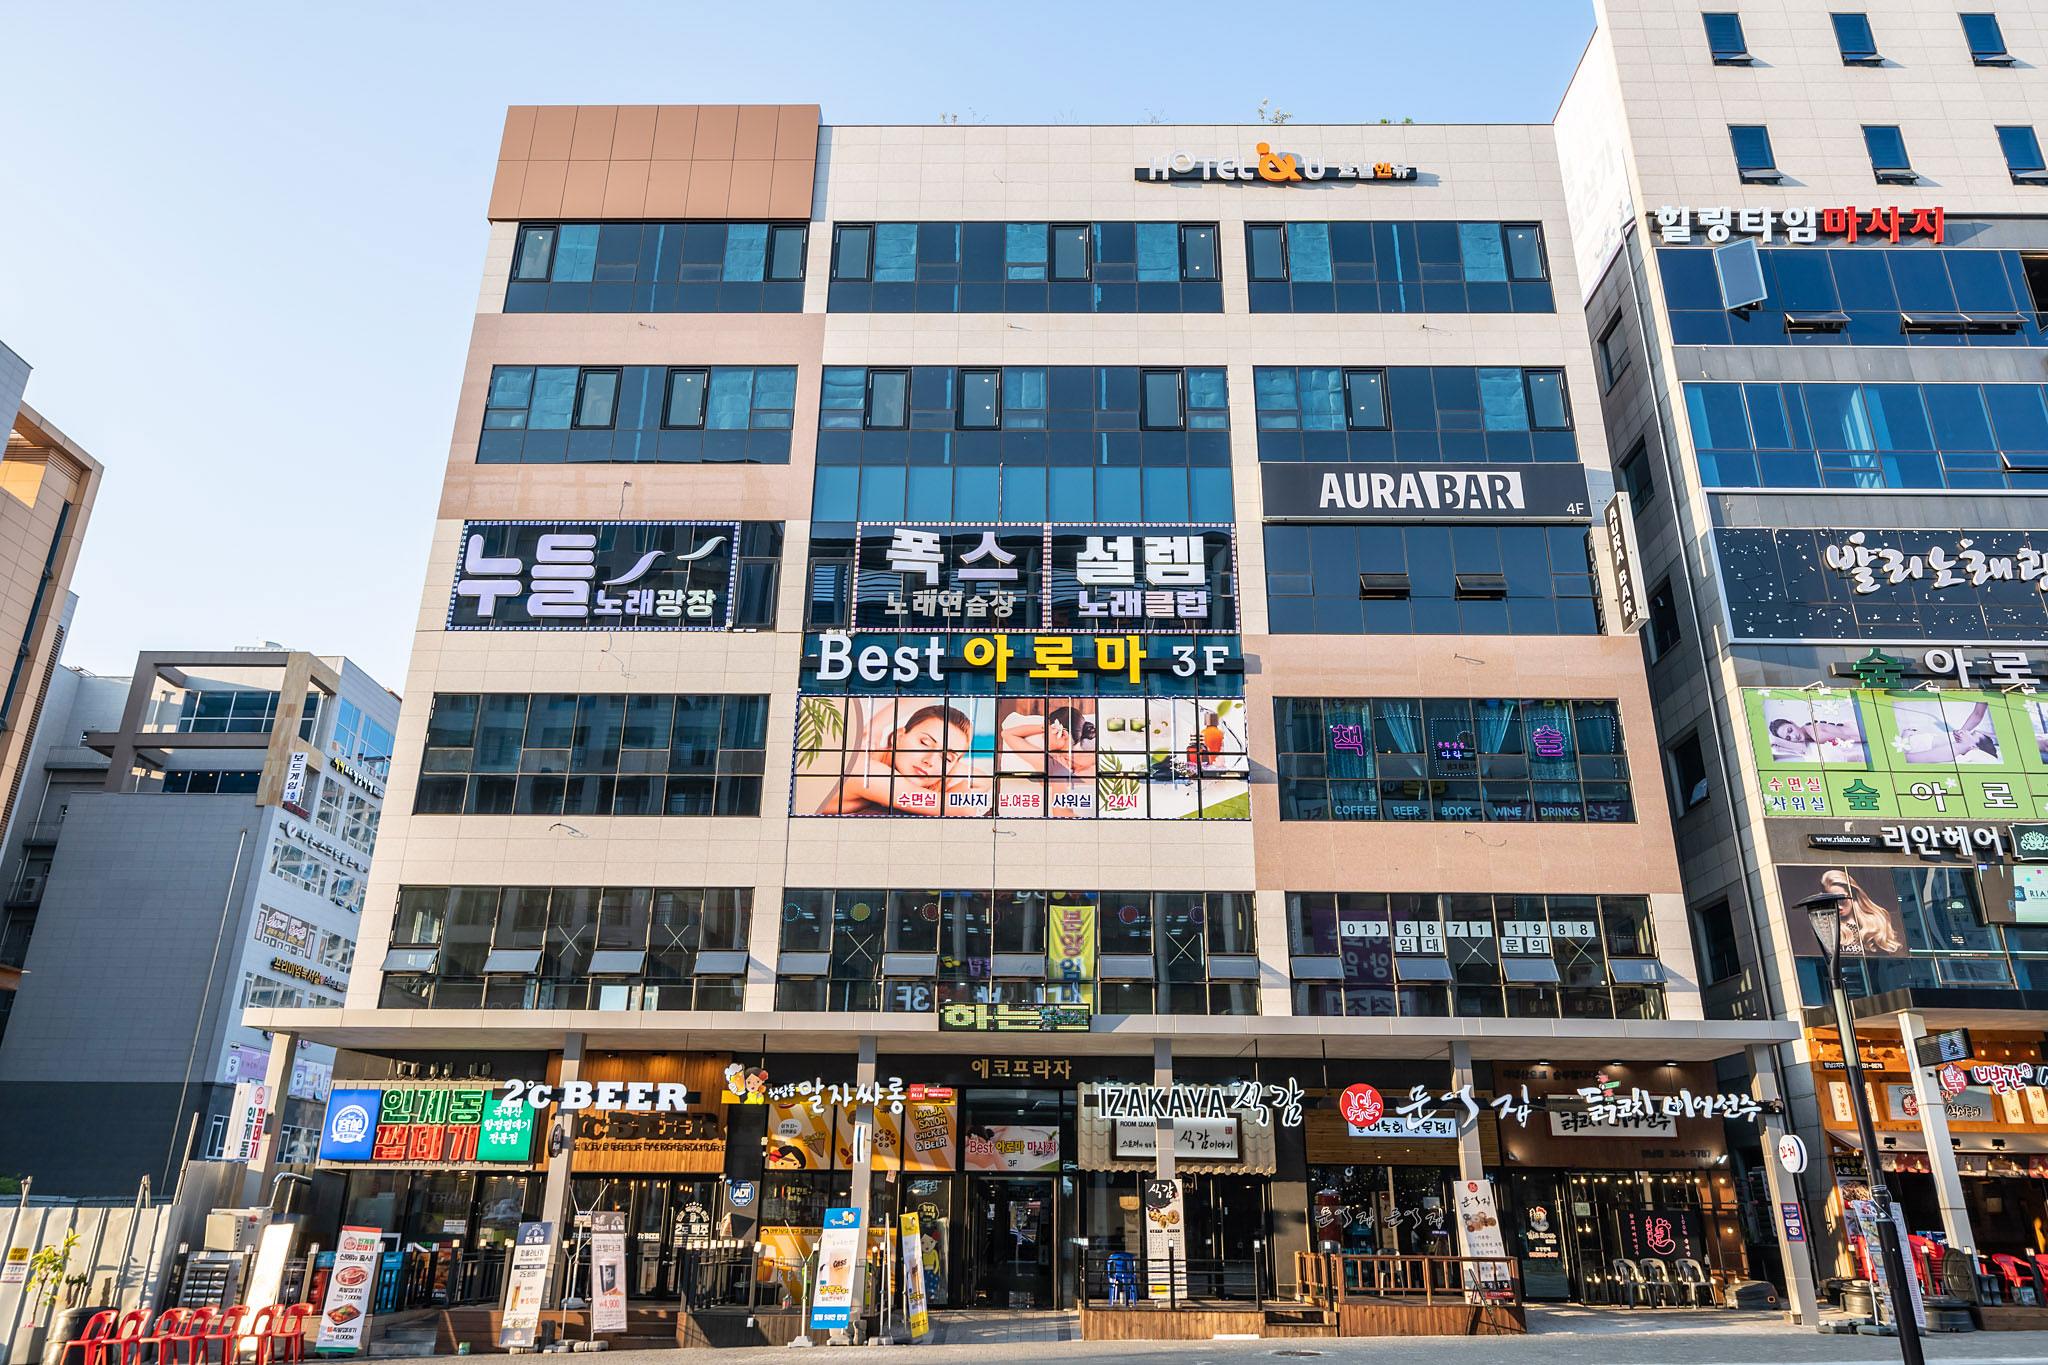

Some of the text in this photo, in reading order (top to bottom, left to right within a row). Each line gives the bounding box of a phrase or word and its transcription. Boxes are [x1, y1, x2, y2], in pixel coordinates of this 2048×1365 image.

[1149, 150, 1254, 181] HOTEL
[1319, 472, 1584, 515] AURA BAR 4F
[885, 528, 1019, 586] 폭스
[1076, 534, 1206, 586] 설렘
[1609, 505, 1625, 565] AURA
[1619, 568, 1633, 618] BAR
[593, 588, 717, 618] 노래광장
[884, 590, 1017, 619] 노래연습장
[1078, 590, 1208, 619] 노래클럽
[816, 633, 1229, 684] Best 아로마 3F
[287, 753, 304, 790] 보드게임
[1768, 777, 1822, 793] 수면실
[898, 792, 937, 808] 수면실
[950, 792, 988, 808] 마사지
[1053, 792, 1092, 808] 샤워실
[1108, 793, 1138, 809] 24시
[1771, 796, 1825, 812] 샤워실
[1843, 778, 1880, 810] 숲
[1335, 805, 1580, 818] COFFEE BEER BOOK WINE DRINKS
[1815, 835, 1871, 845] www.riahn.co.kr
[1881, 825, 2004, 856] 리안헤어
[1398, 937, 1547, 952] 임대 문의
[972, 1059, 1072, 1080] 에코프라자
[1973, 1063, 2027, 1095] 빨간
[381, 1089, 484, 1124] 인계동
[561, 1081, 689, 1111] BEER
[798, 1076, 907, 1114] 말자싸롱
[1097, 1077, 1305, 1127] IZAKAYA 식감
[1662, 1087, 1762, 1123] 비어선수
[915, 1106, 945, 1119] MALJA
[918, 1117, 948, 1131] SALON
[239, 1107, 256, 1158] 인계동
[250, 1108, 266, 1159] 껍데기
[372, 1124, 481, 1160] 껍데기
[914, 1128, 949, 1141] CHICKEN
[924, 1138, 948, 1151] BEER
[969, 1140, 1058, 1154] Best 아로마 마사지
[733, 1189, 750, 1199] ADT
[1147, 1183, 1176, 1199] 식감
